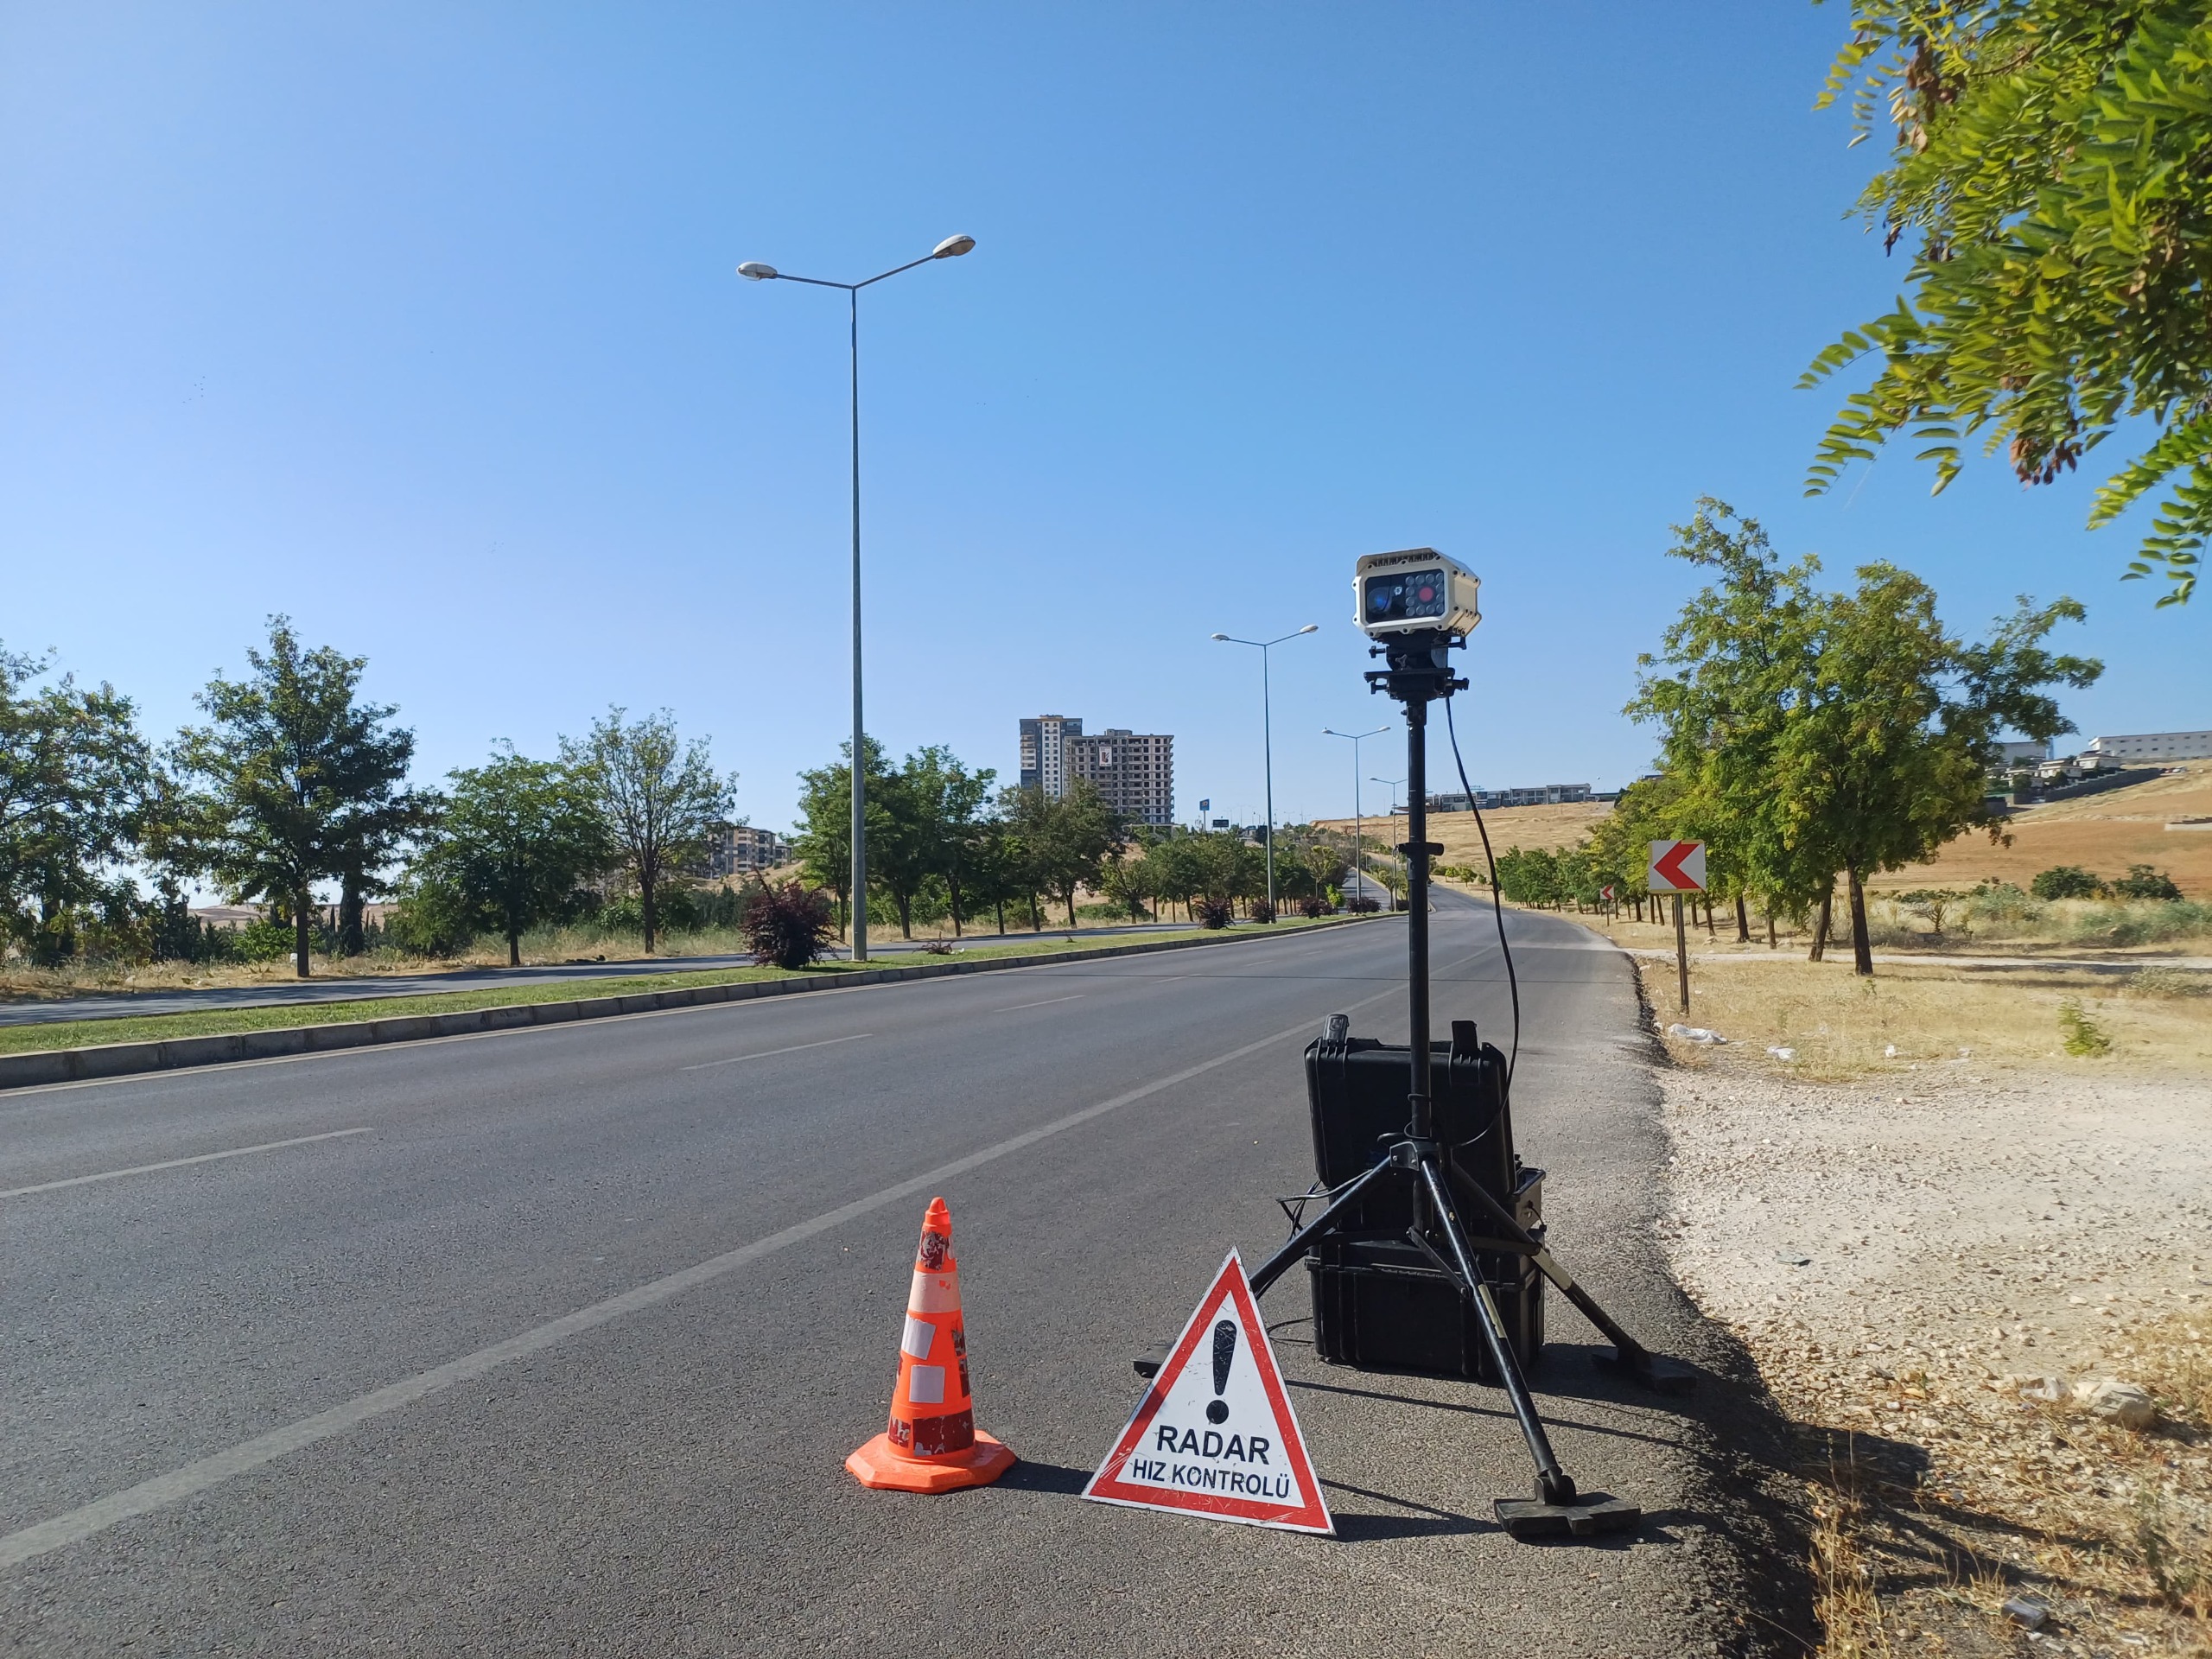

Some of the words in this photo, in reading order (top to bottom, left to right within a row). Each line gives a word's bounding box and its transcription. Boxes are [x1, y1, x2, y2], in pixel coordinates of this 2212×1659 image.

[1157, 1425, 1270, 1465] RADAR
[1133, 1459, 1166, 1482] HIZ
[1172, 1464, 1290, 1498] KONTROLÜ
